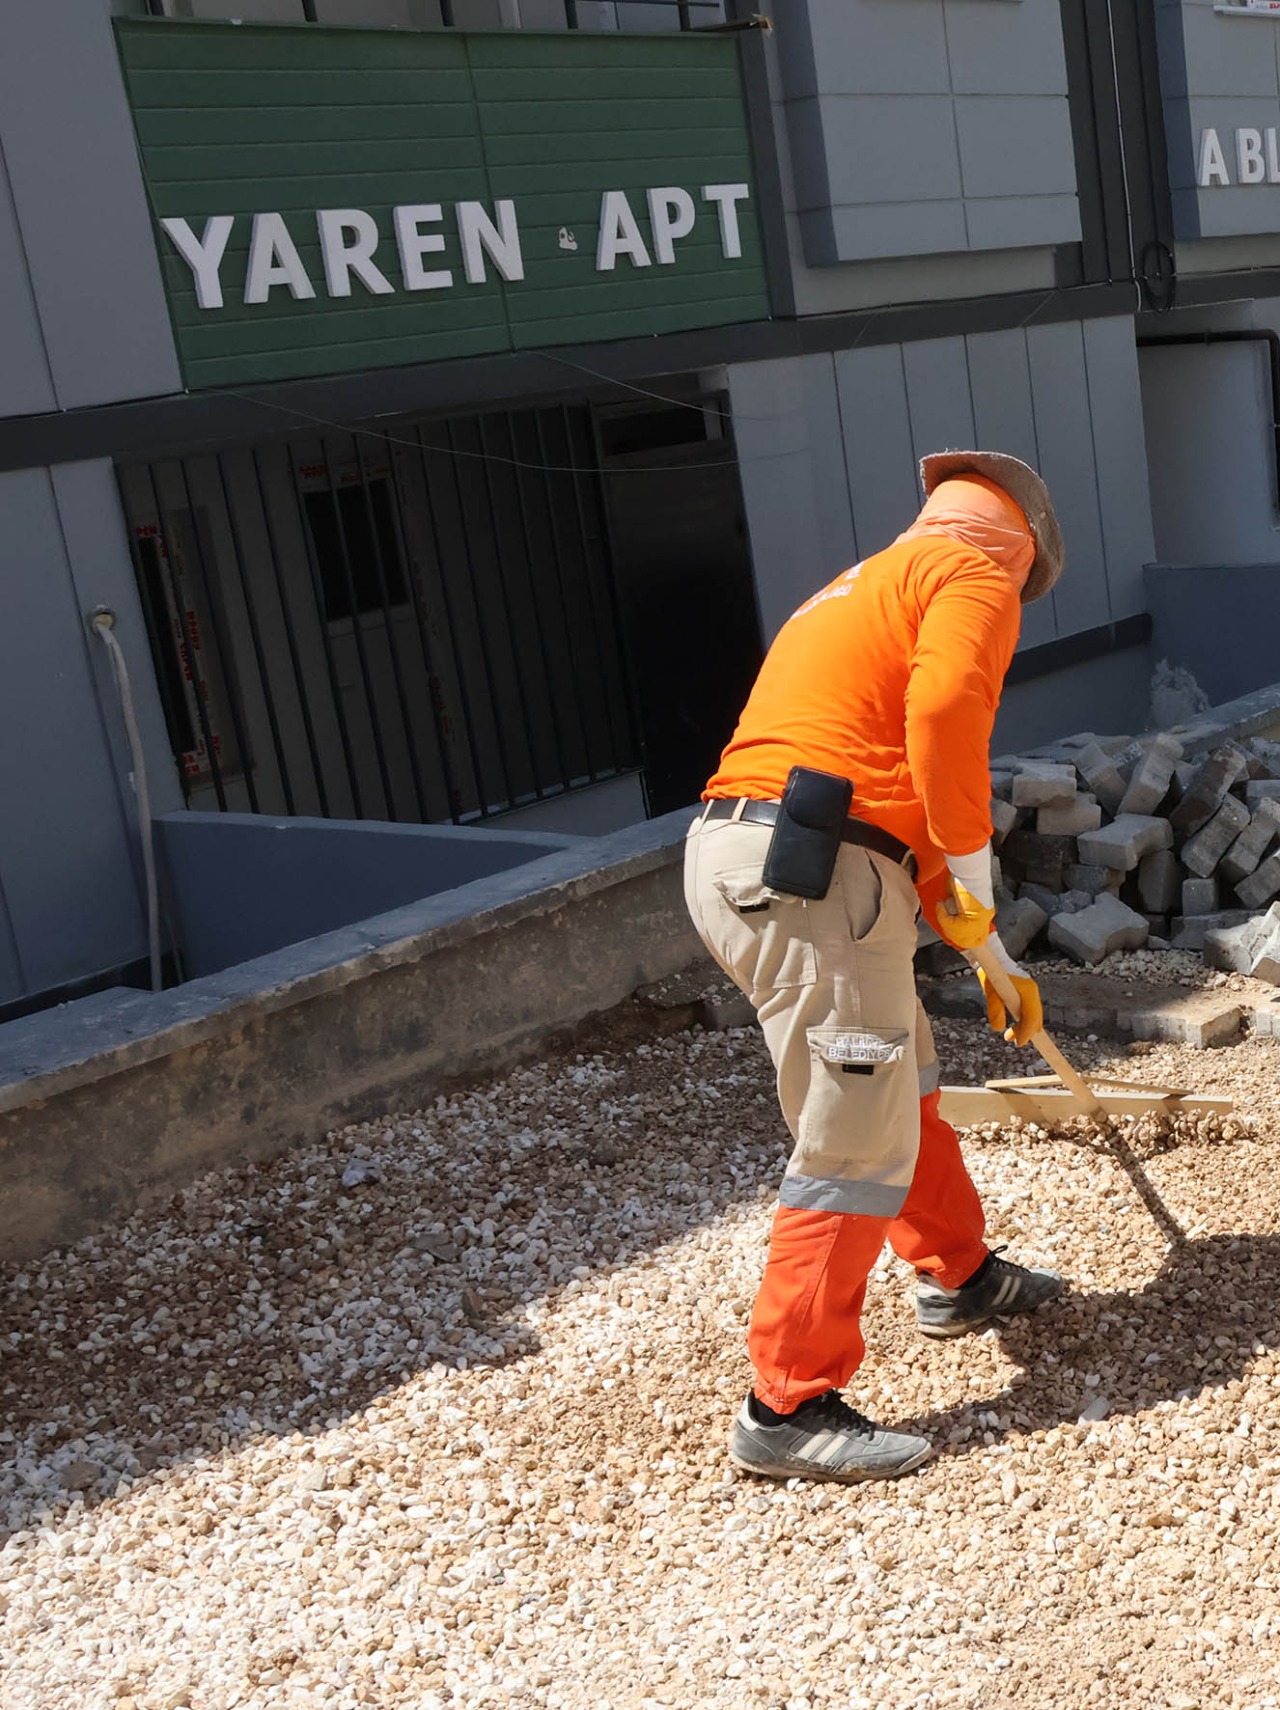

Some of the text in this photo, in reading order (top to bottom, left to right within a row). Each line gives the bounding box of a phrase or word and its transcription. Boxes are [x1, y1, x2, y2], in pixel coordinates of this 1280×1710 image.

[1198, 127, 1230, 187] A
[160, 183, 750, 310] YAREN APT
